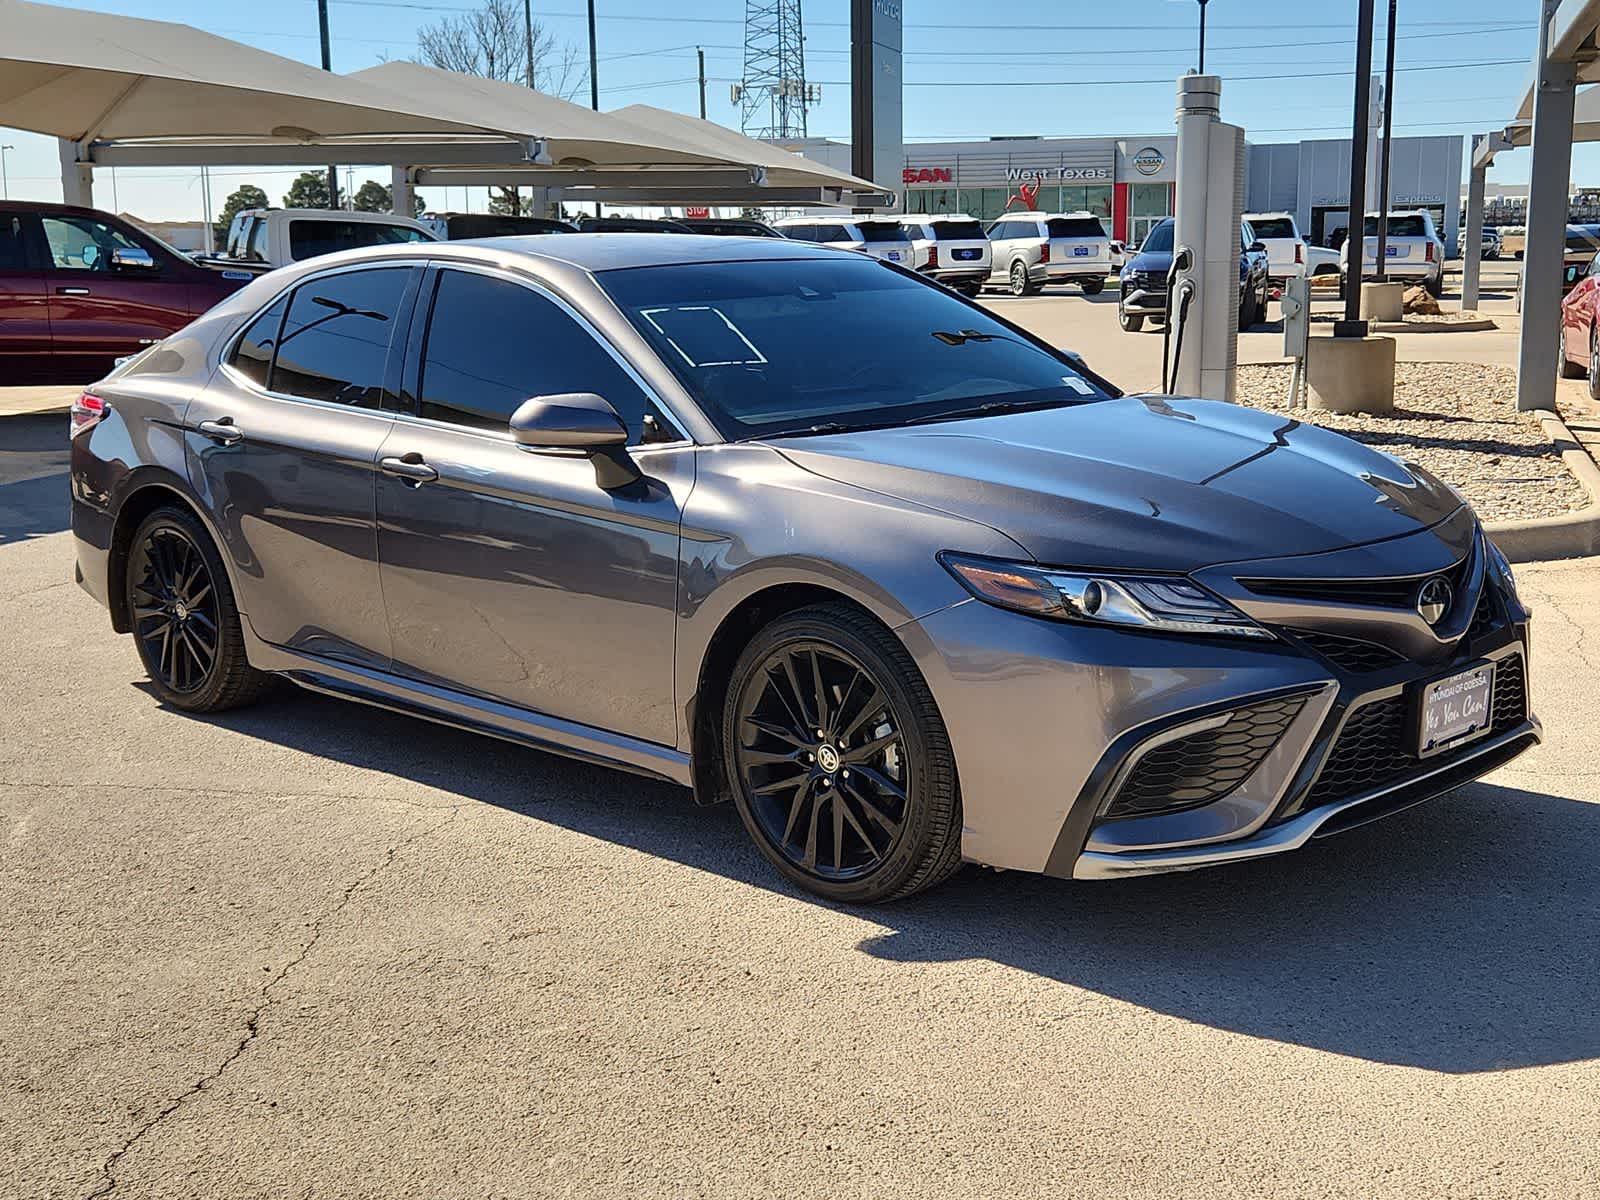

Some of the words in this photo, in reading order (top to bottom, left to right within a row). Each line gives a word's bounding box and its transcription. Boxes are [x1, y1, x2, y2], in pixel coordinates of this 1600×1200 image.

[1135, 158, 1163, 166] NISSAN
[902, 168, 952, 183] SAN
[1005, 168, 1049, 181] West
[1054, 167, 1107, 179] Texas
[687, 207, 706, 215] STOP
[1444, 701, 1460, 726] You
[1462, 687, 1489, 717] Can!
